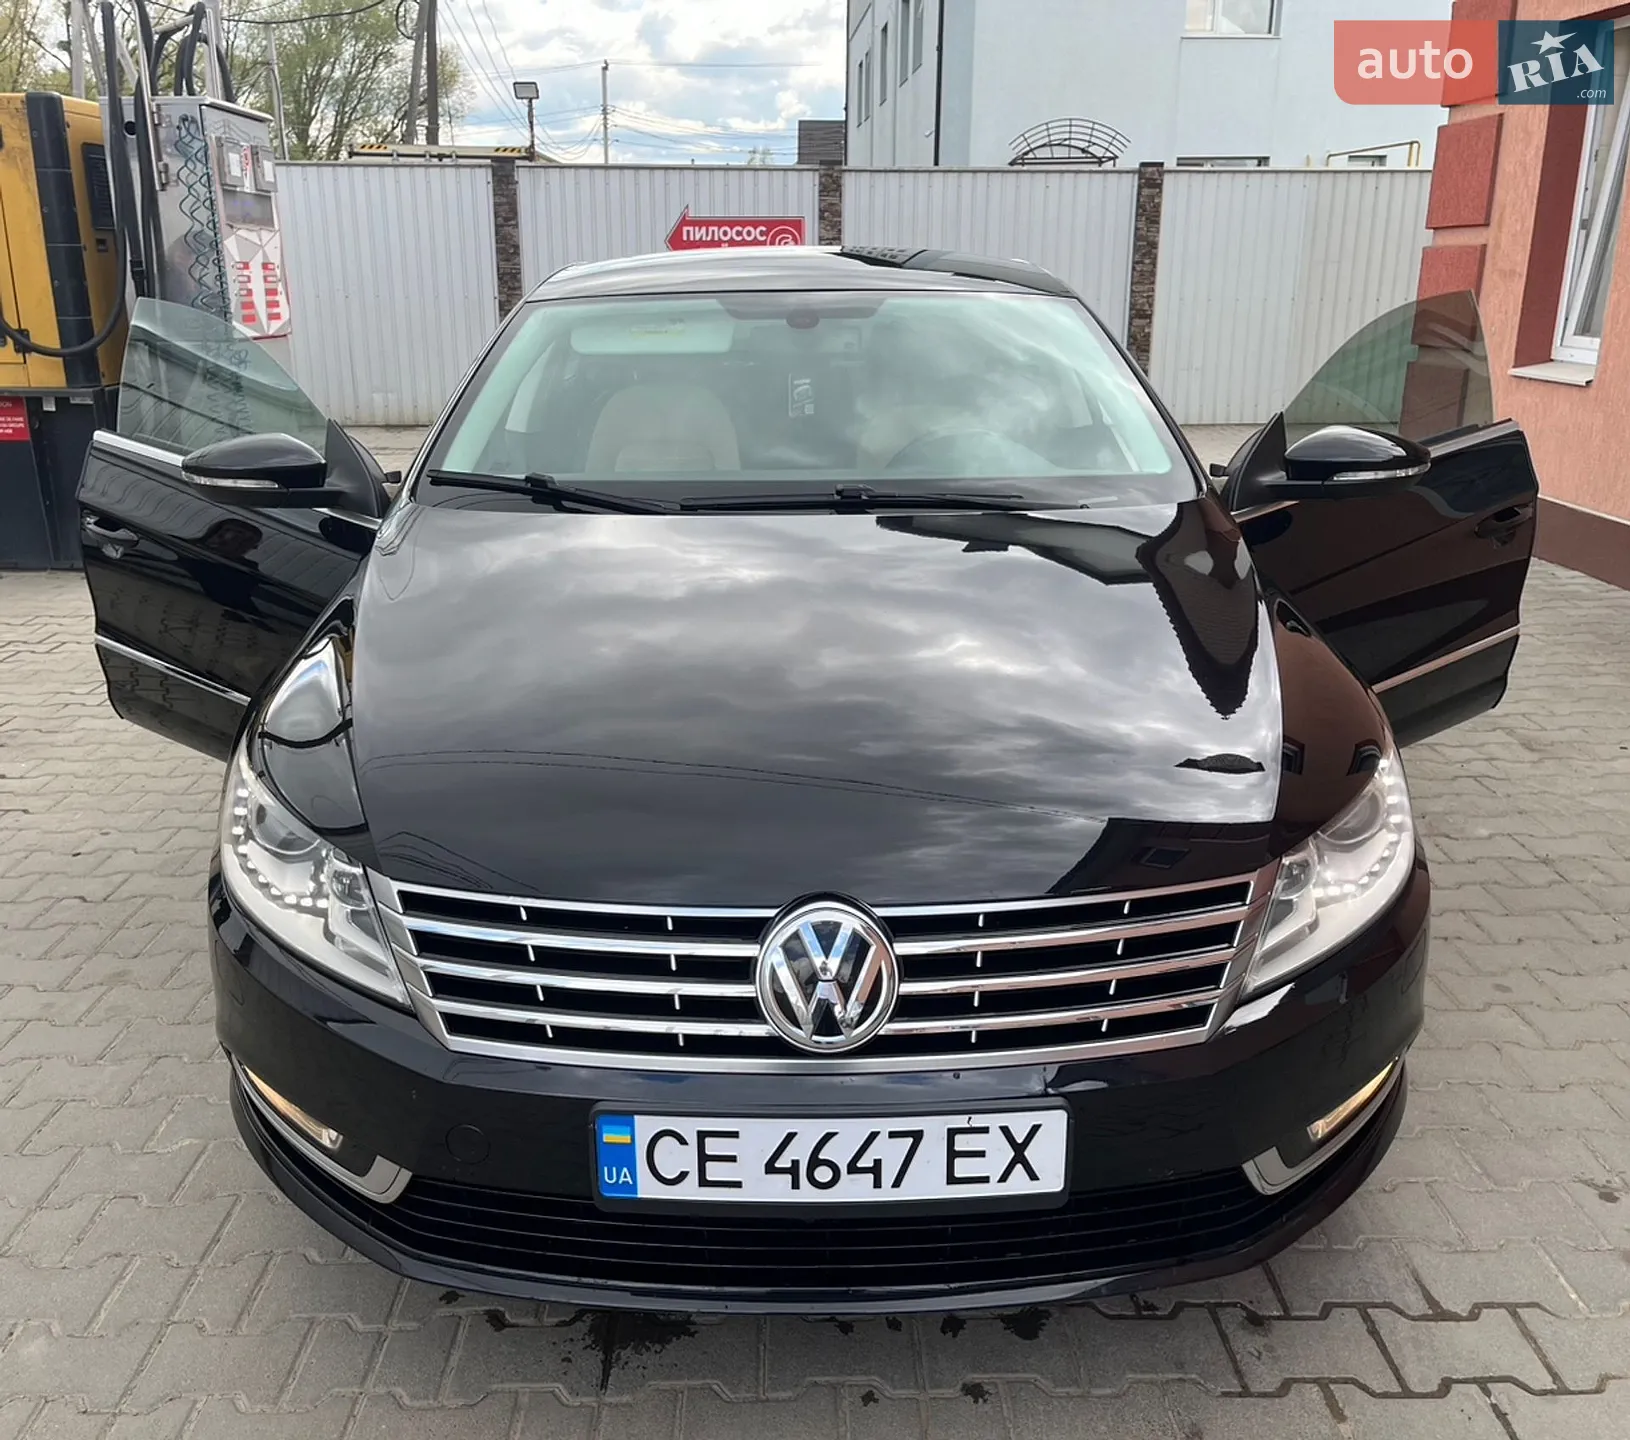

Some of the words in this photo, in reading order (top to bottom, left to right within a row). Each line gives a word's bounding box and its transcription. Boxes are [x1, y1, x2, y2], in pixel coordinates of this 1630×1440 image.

[682, 226, 767, 241] ПИЛОСОС
[645, 1128, 743, 1188] CE
[764, 1130, 924, 1189] 4647
[946, 1123, 1042, 1185] EX
[604, 1167, 633, 1185] UA
